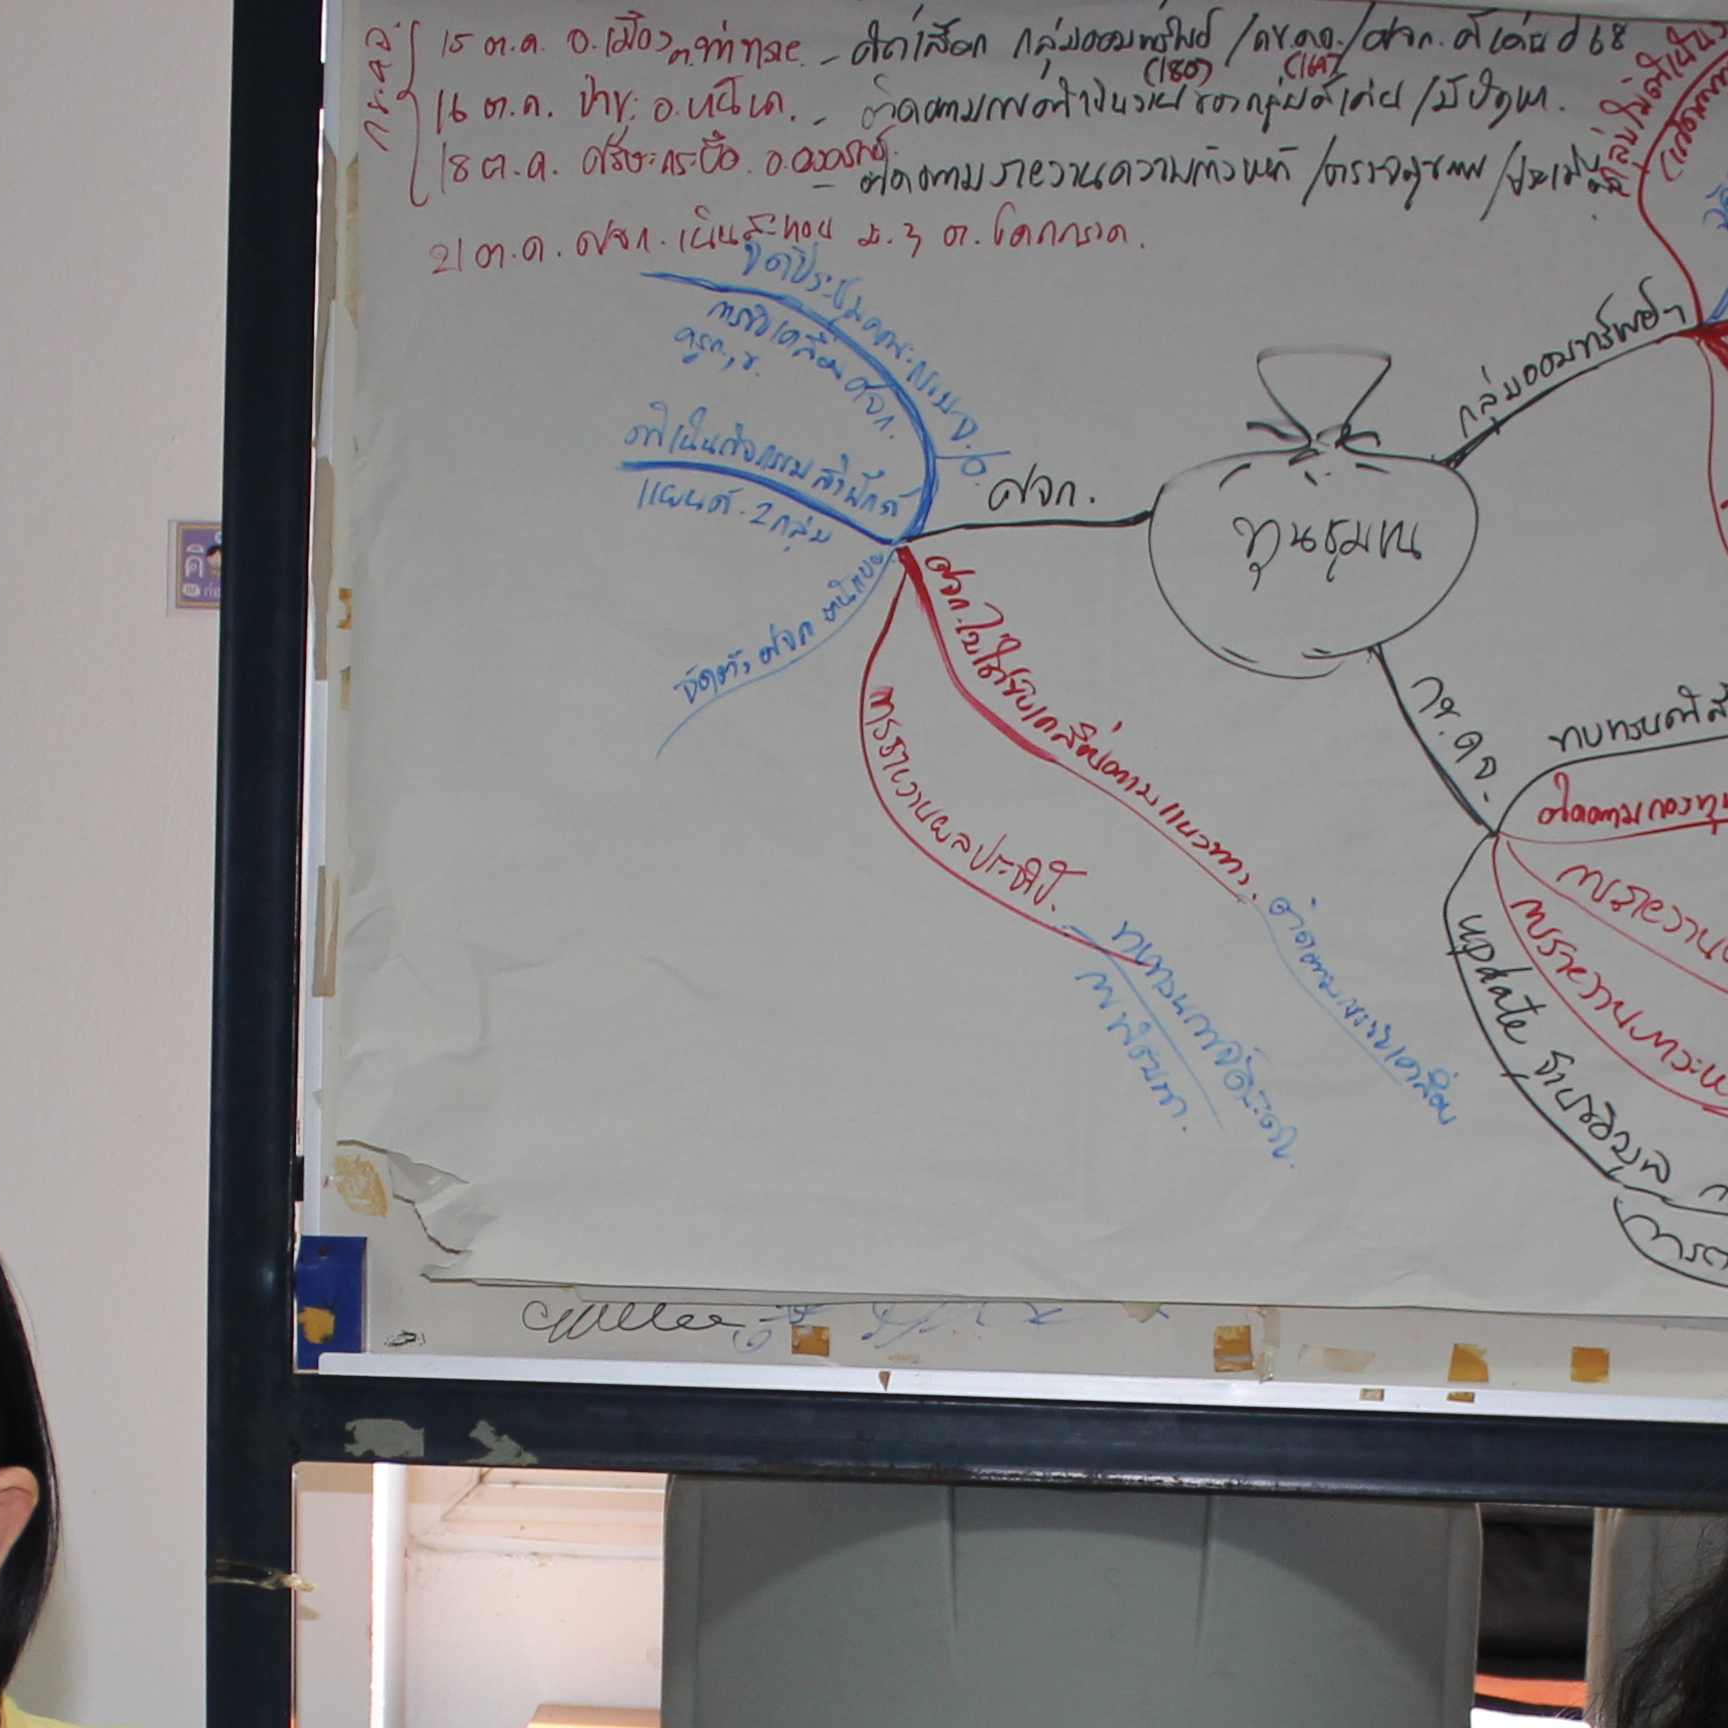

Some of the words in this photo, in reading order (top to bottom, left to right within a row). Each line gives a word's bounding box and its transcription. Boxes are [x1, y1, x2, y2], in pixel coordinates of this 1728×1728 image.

[441, 30, 474, 57] 15
[1589, 22, 1627, 55] 68
[436, 89, 469, 135] 16
[441, 142, 469, 194] 18
